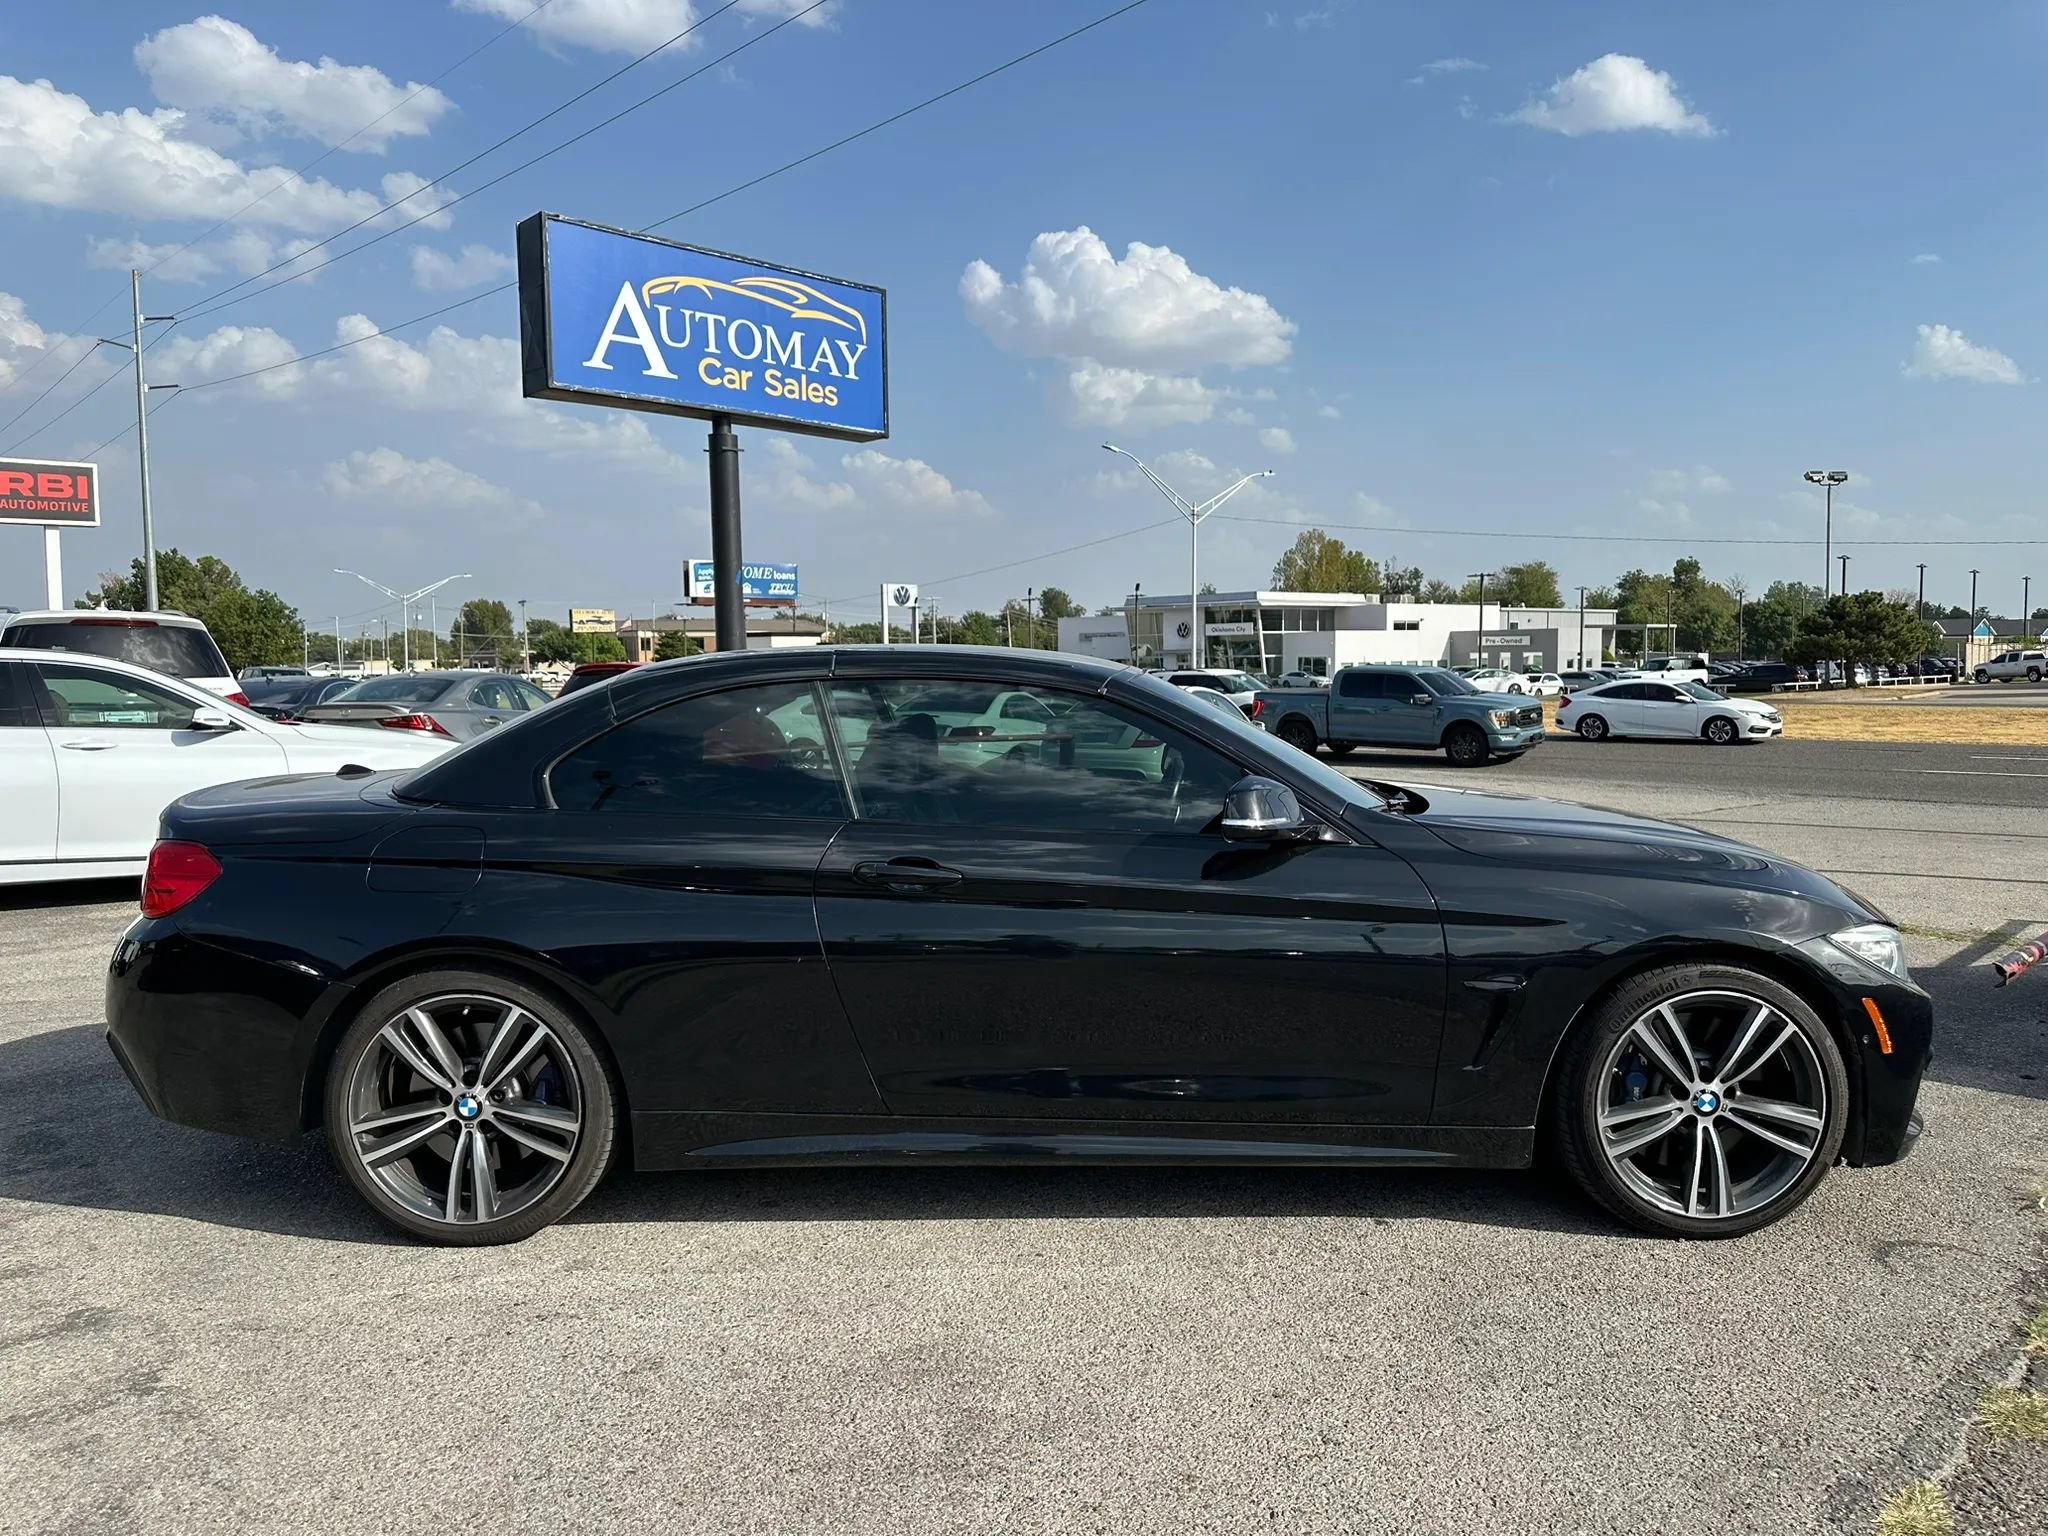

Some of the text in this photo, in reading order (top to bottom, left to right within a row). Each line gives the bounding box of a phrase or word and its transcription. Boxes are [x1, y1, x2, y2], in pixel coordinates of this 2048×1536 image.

[583, 281, 867, 380] AUTOMAY
[698, 357, 838, 407] Car Sales
[0, 471, 88, 499] RBI
[0, 499, 89, 512] AUTOMOTIVE
[742, 566, 796, 580] OME loans
